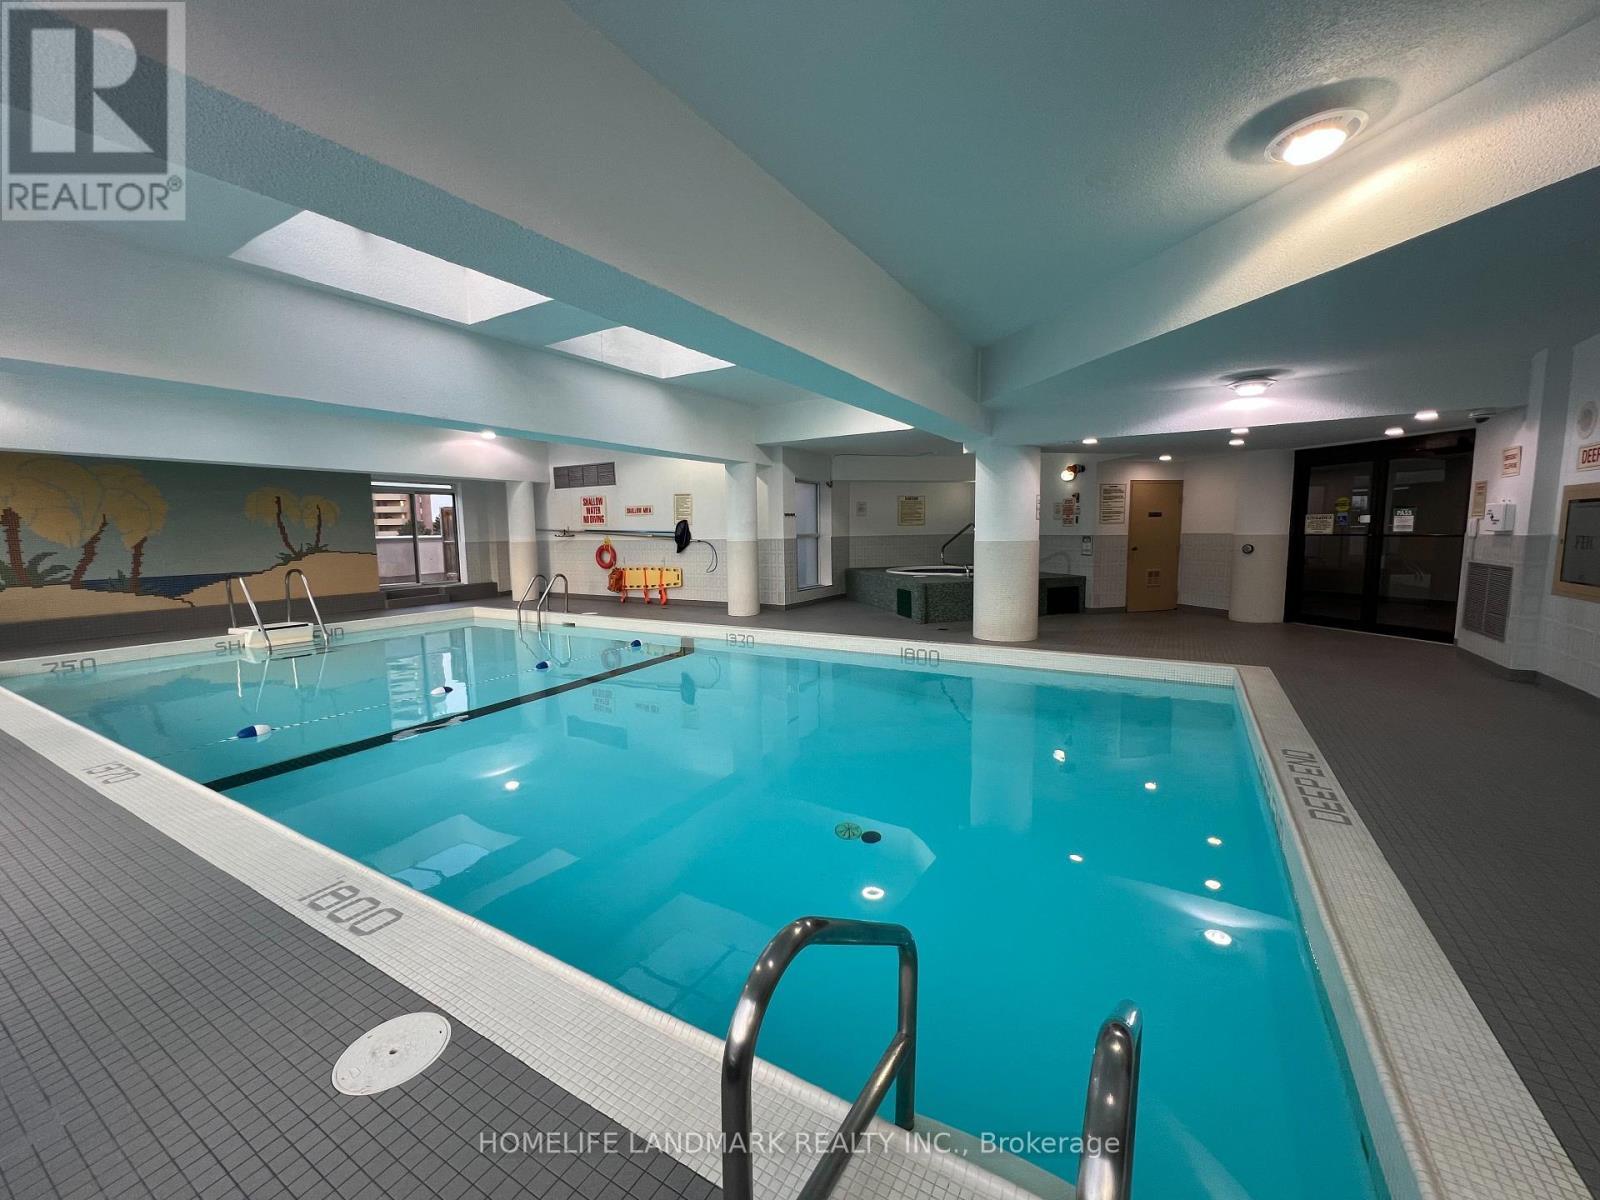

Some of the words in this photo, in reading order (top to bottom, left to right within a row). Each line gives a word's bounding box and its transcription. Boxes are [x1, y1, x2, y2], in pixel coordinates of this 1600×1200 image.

[583, 515, 590, 524] NO
[590, 515, 605, 524] DIVING
[585, 506, 601, 515] WATER
[1281, 748, 1326, 778] END
[1294, 777, 1353, 826] DEEP
[299, 874, 405, 937] 1800
